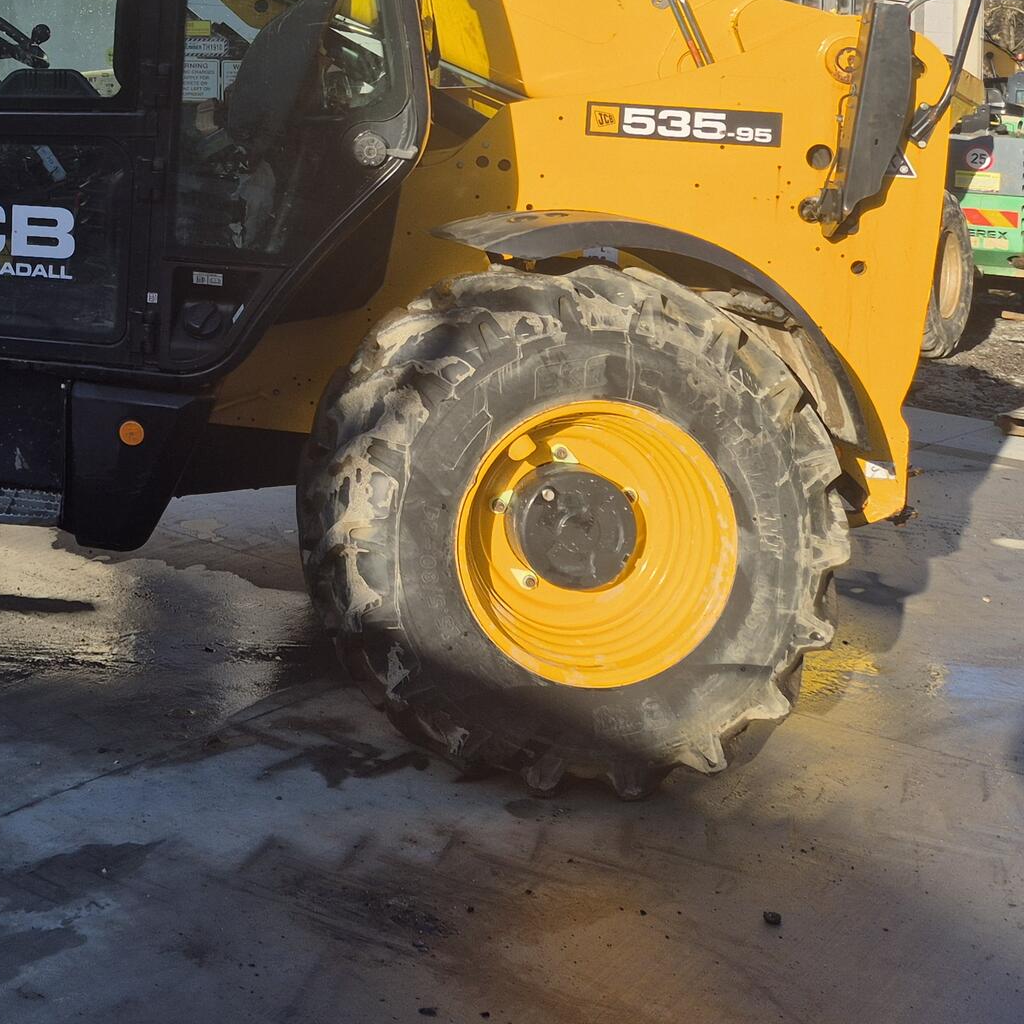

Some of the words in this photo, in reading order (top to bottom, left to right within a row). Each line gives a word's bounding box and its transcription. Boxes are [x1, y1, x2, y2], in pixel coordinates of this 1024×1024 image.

[622, 107, 773, 144] 535-95
[970, 152, 987, 165] 25
[967, 228, 1008, 240] EREX
